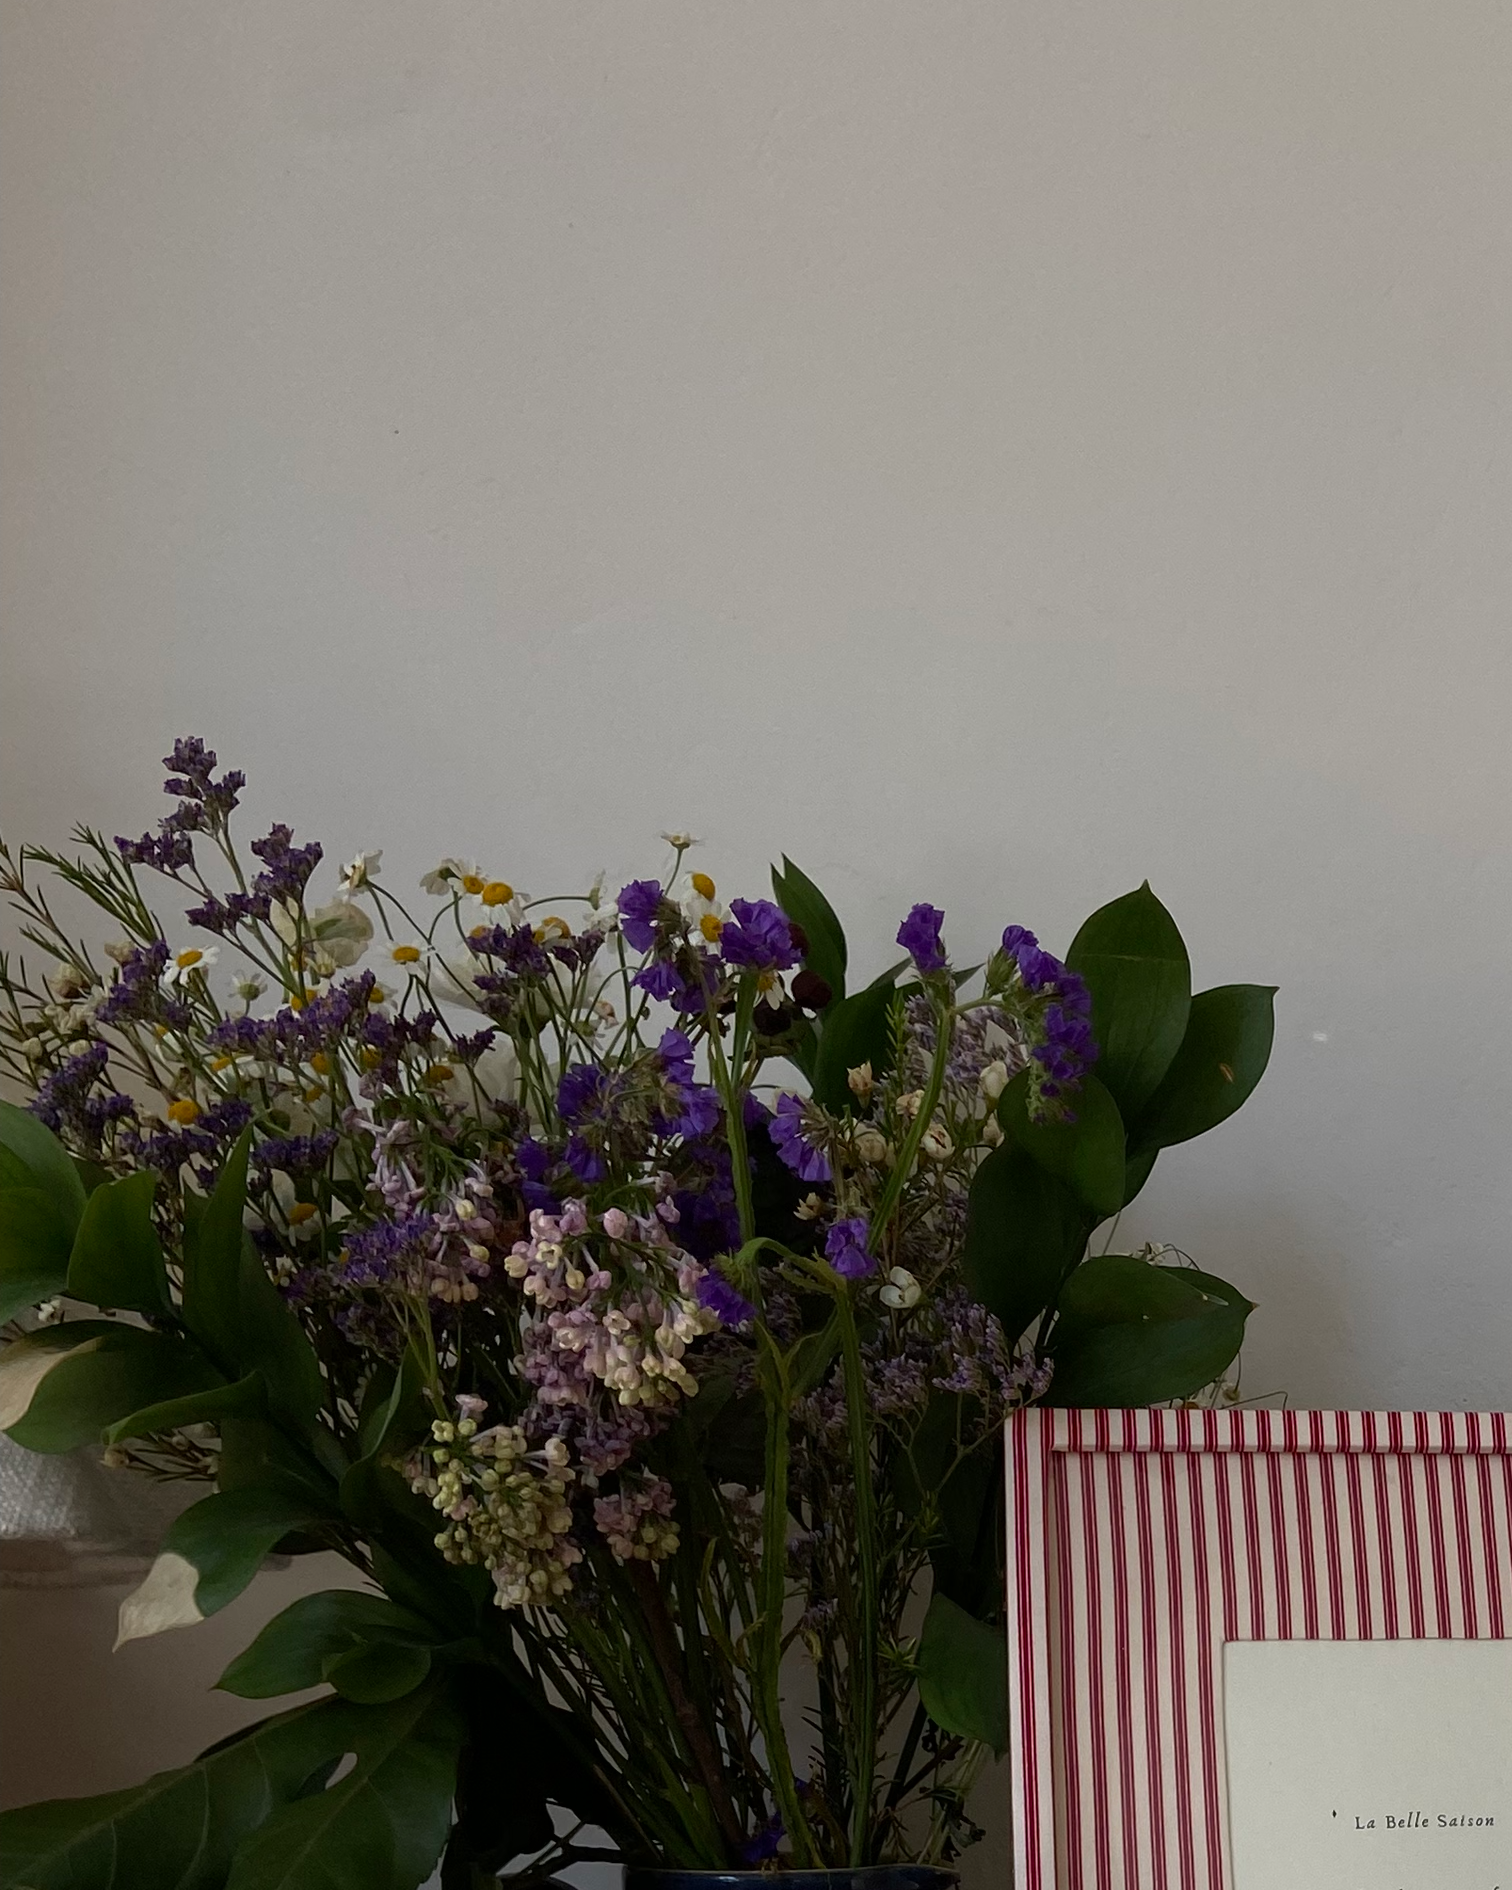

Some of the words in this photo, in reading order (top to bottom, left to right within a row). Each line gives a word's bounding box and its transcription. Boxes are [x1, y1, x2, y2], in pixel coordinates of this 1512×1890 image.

[1354, 1815, 1377, 1830] La
[1384, 1810, 1429, 1830] Belle
[1436, 1814, 1495, 1828] Saison
